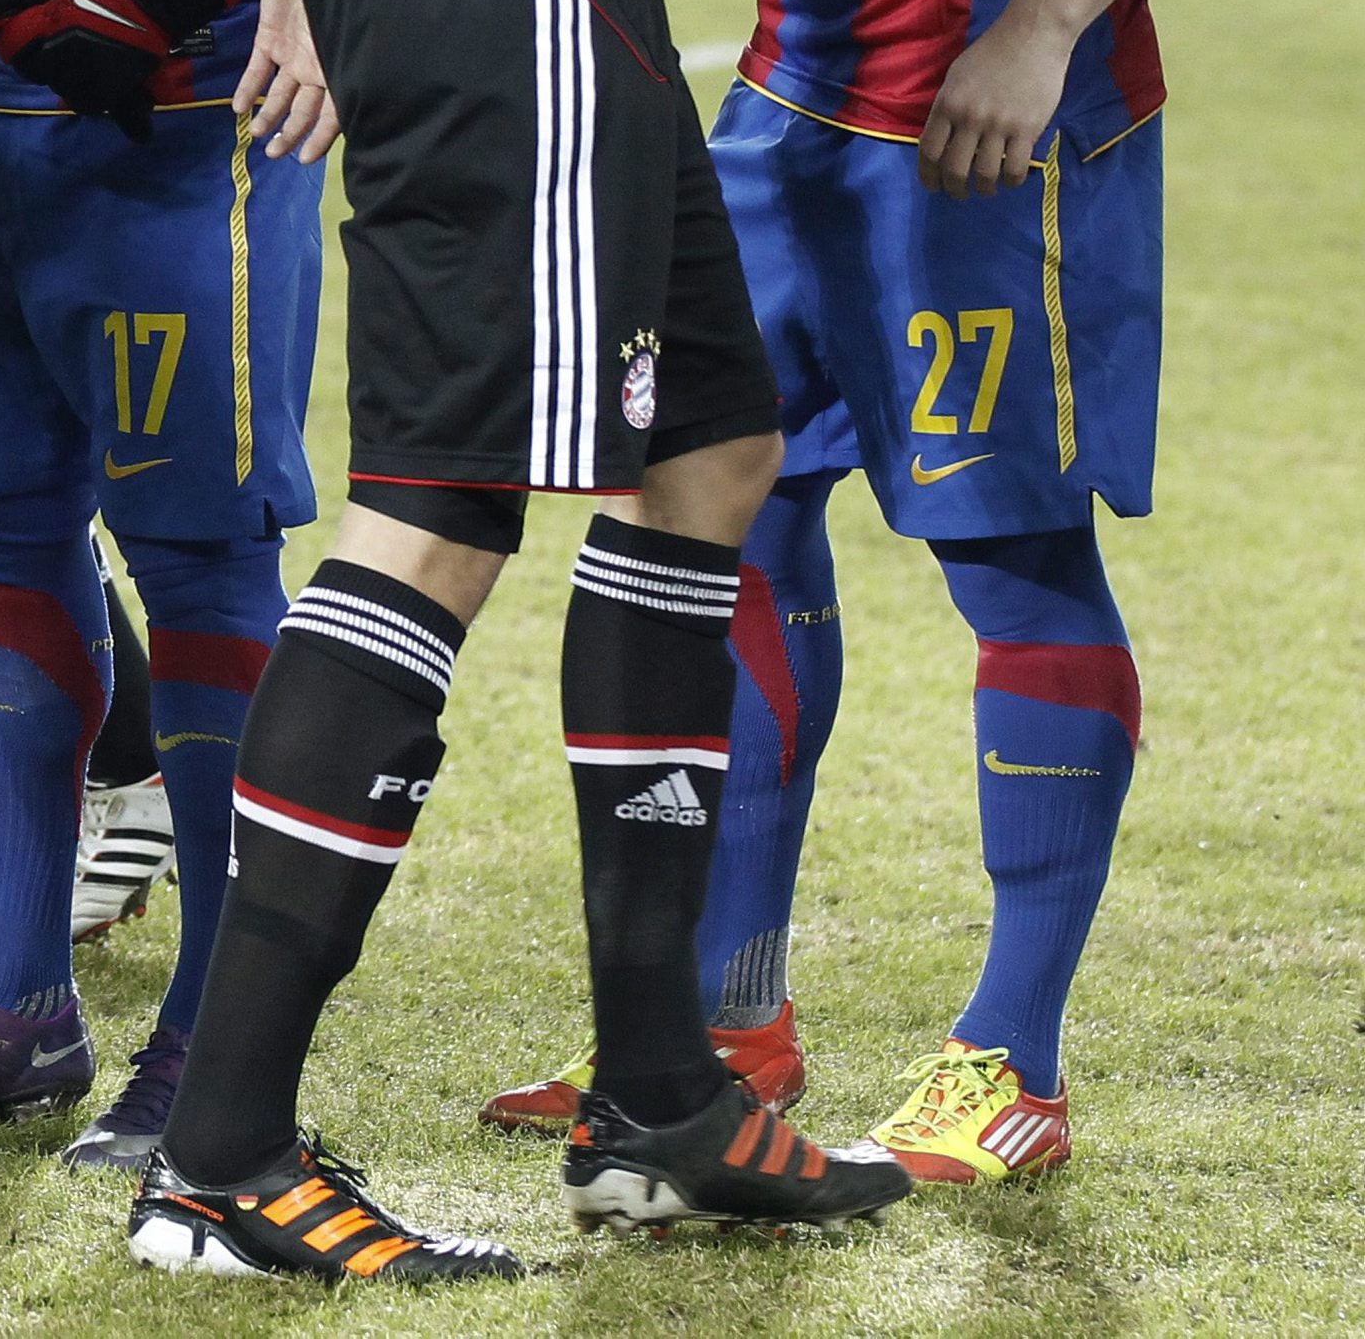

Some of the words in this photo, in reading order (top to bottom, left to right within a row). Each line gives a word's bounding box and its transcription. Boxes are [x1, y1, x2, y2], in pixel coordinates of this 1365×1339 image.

[103, 311, 187, 436] 17
[907, 307, 1014, 435] 27
[614, 801, 708, 827] adidas
